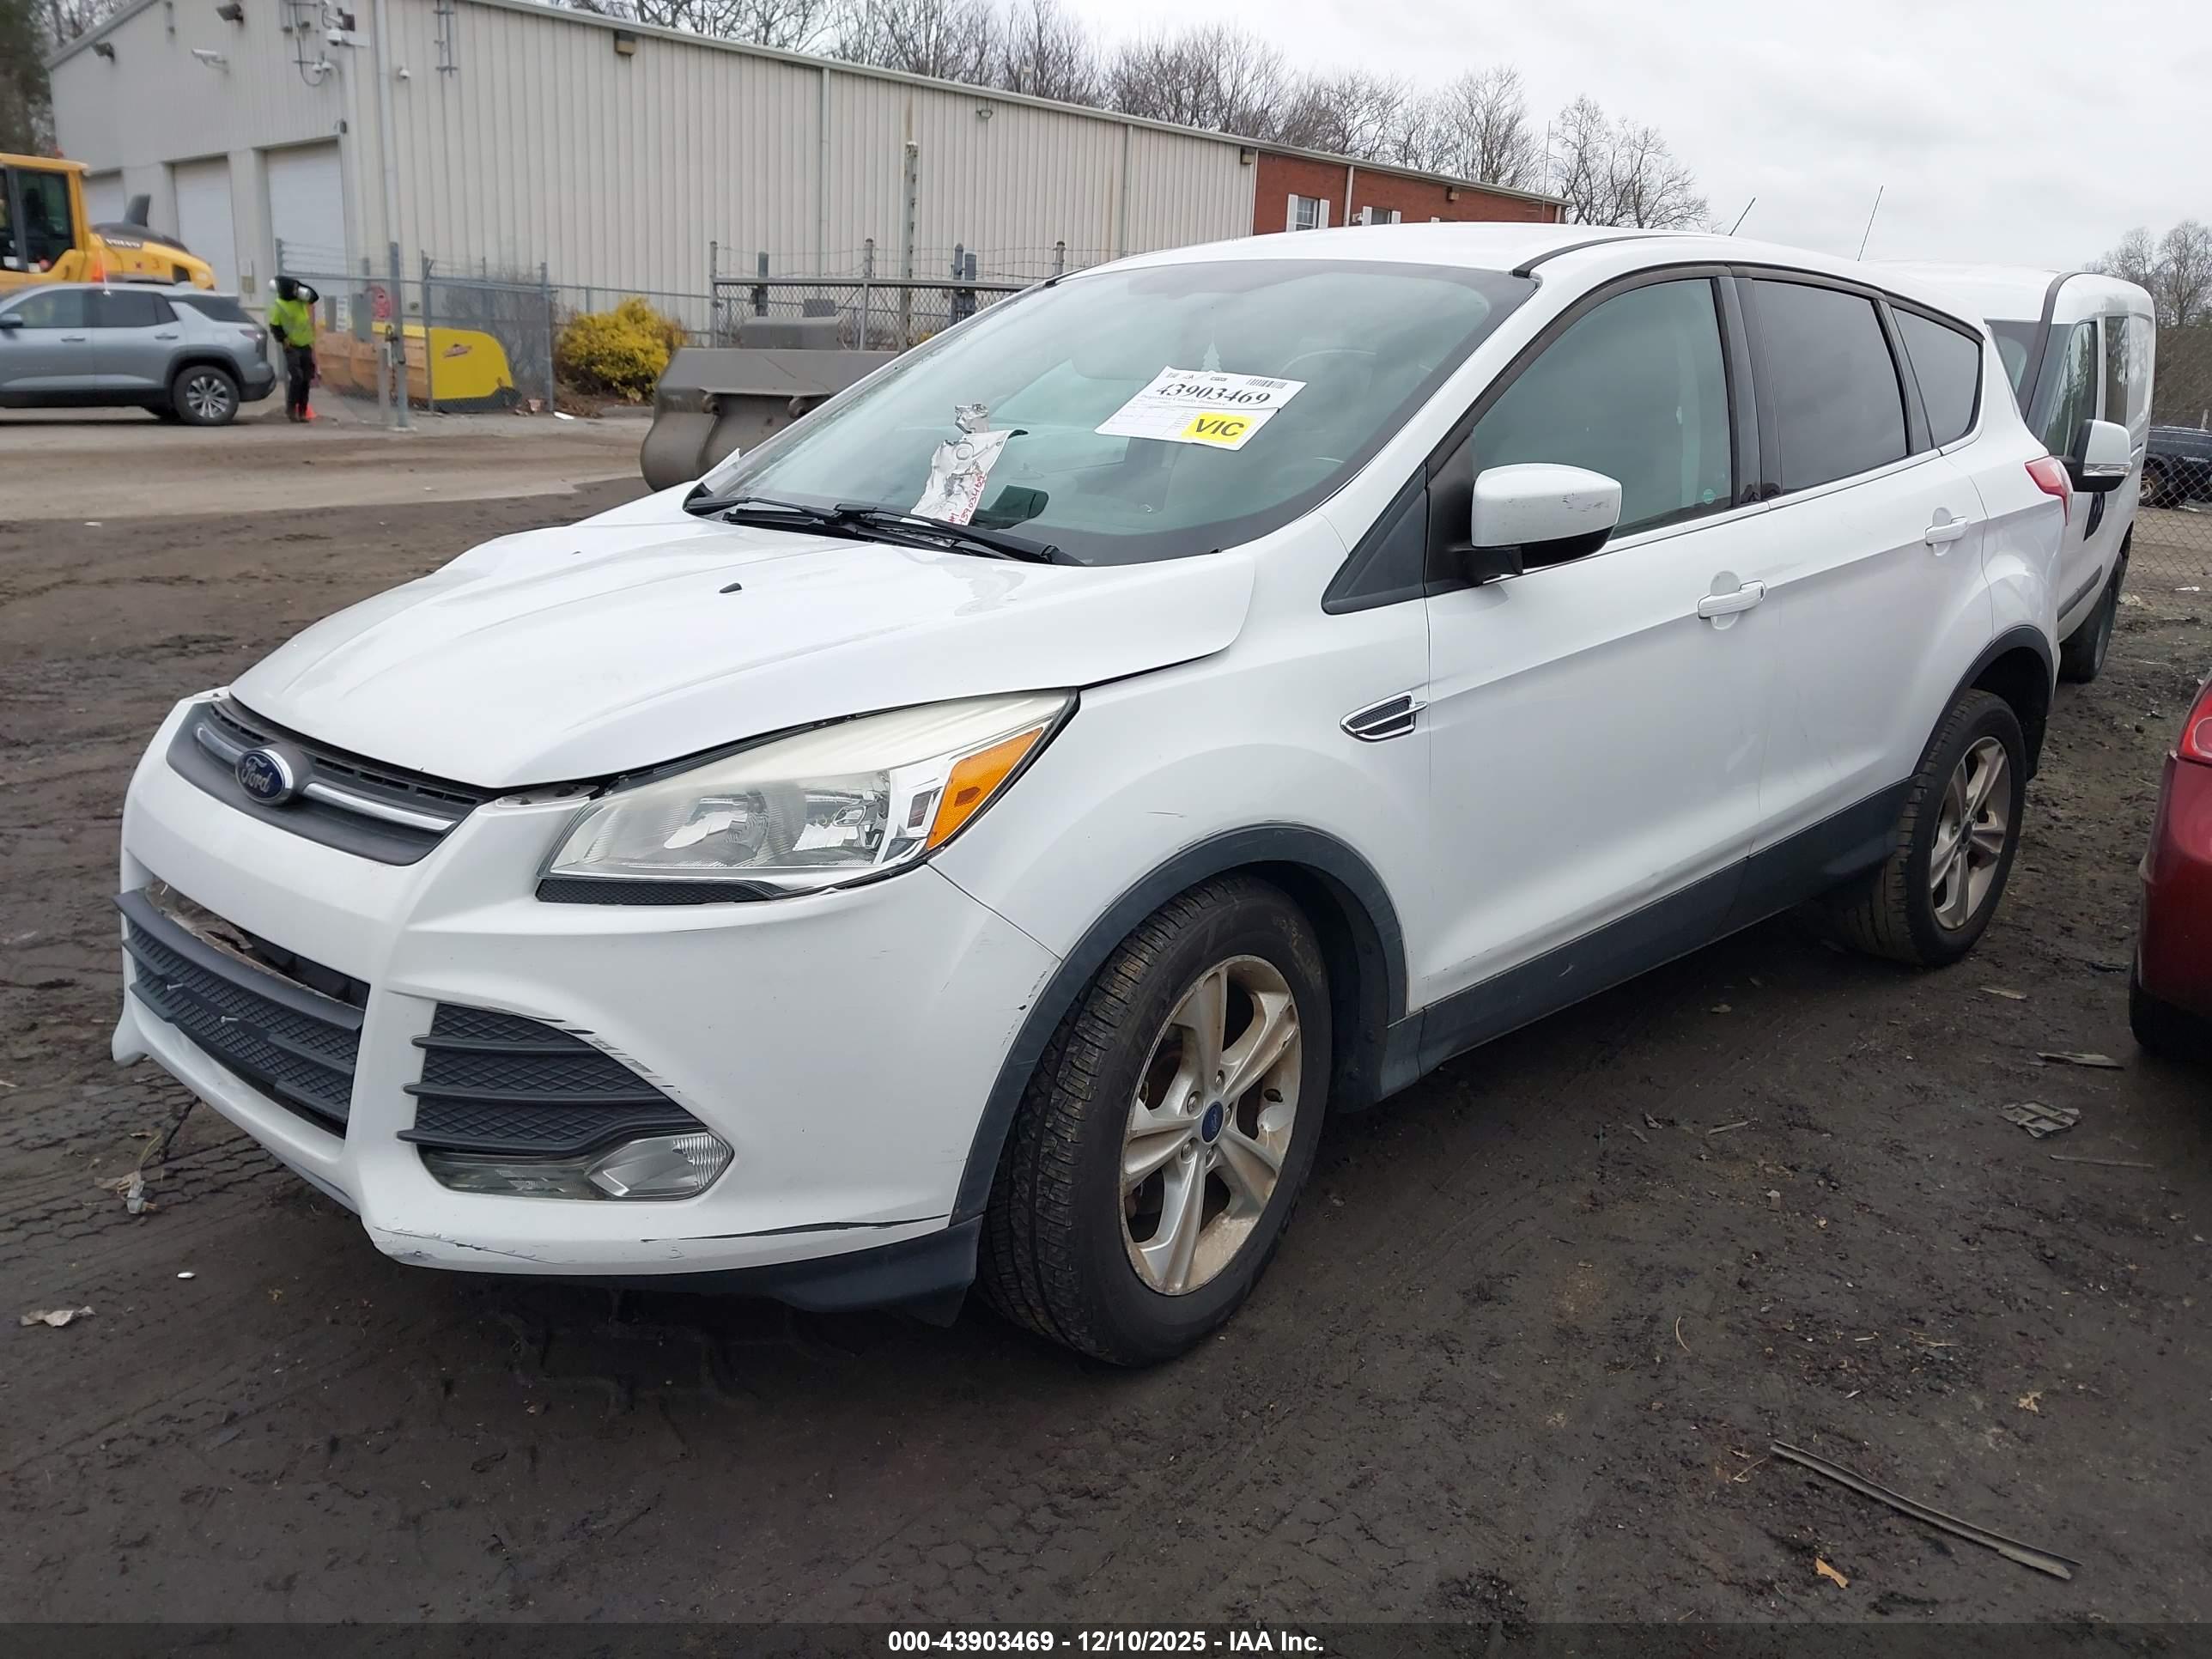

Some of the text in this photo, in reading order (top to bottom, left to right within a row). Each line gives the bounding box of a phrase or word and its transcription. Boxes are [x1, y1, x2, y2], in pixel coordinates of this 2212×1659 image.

[1156, 383, 1271, 404] 43903469
[1196, 418, 1244, 436] VIC
[241, 756, 273, 793] Ford
